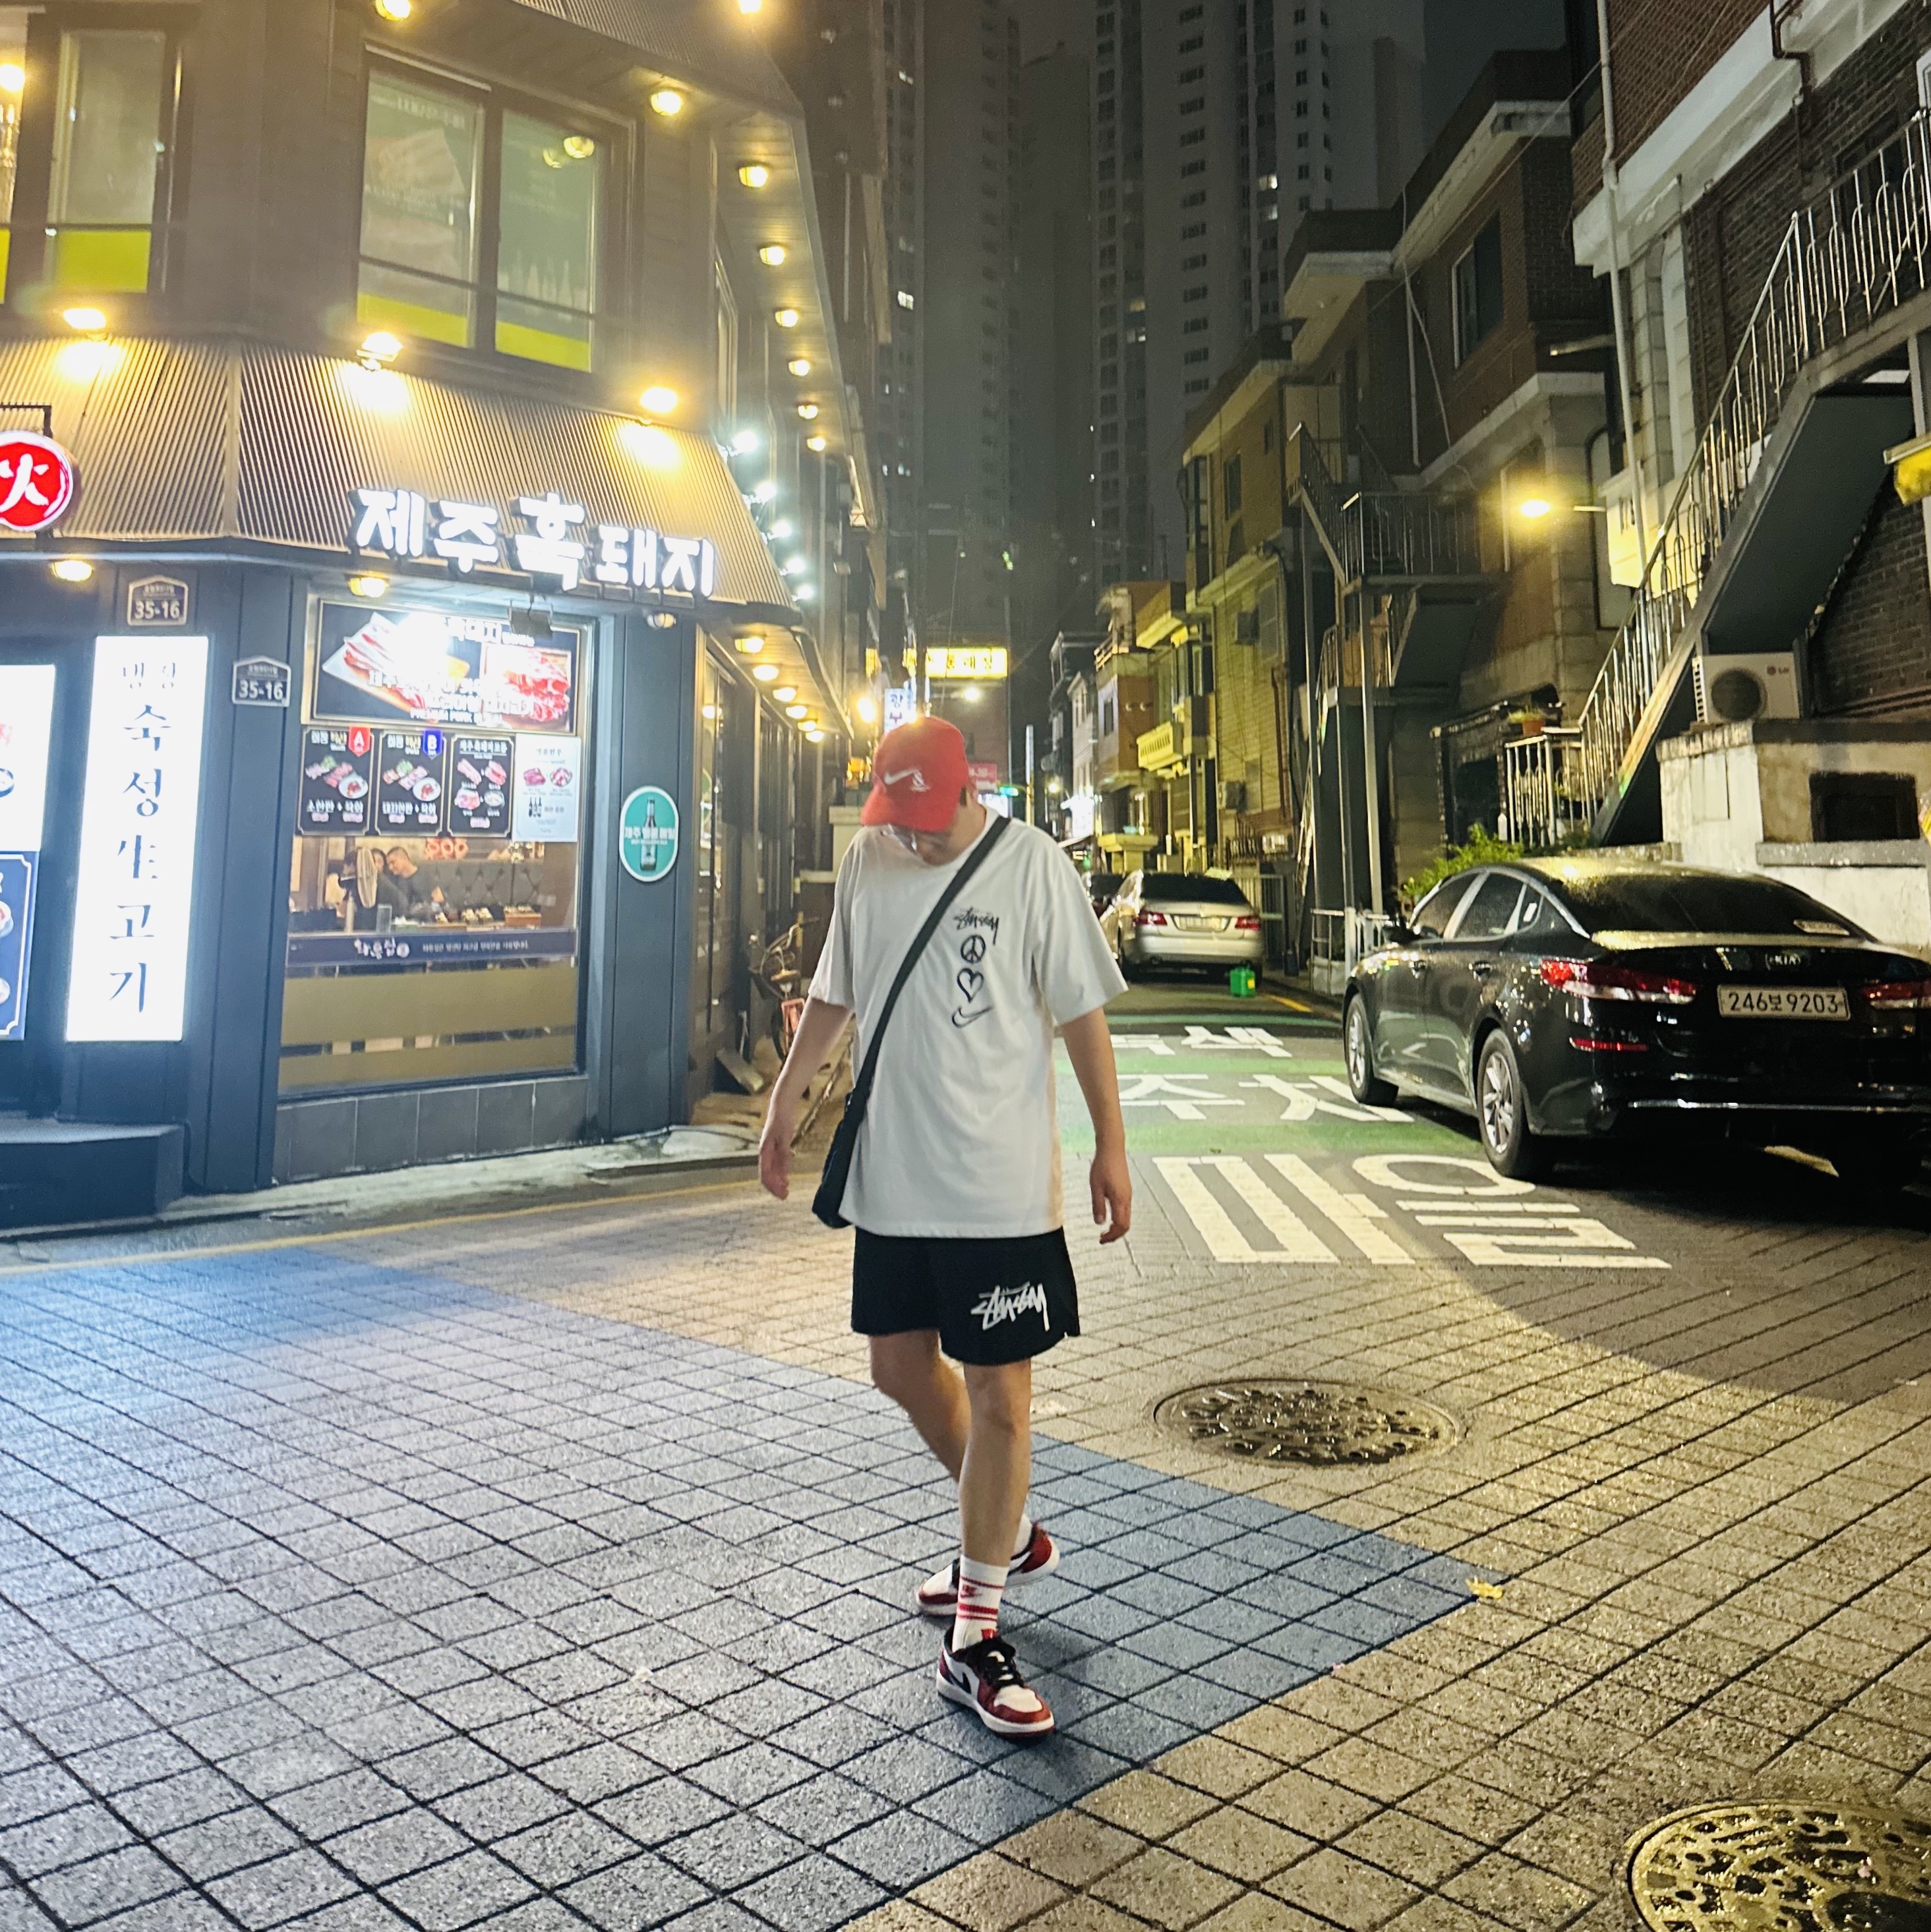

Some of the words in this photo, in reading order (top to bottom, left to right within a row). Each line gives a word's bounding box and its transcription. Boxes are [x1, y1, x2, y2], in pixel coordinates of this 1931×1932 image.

[134, 600, 180, 620] 35-16
[239, 680, 283, 700] 35-16
[354, 730, 365, 746] A
[1152, 1154, 1672, 1269] 마을
